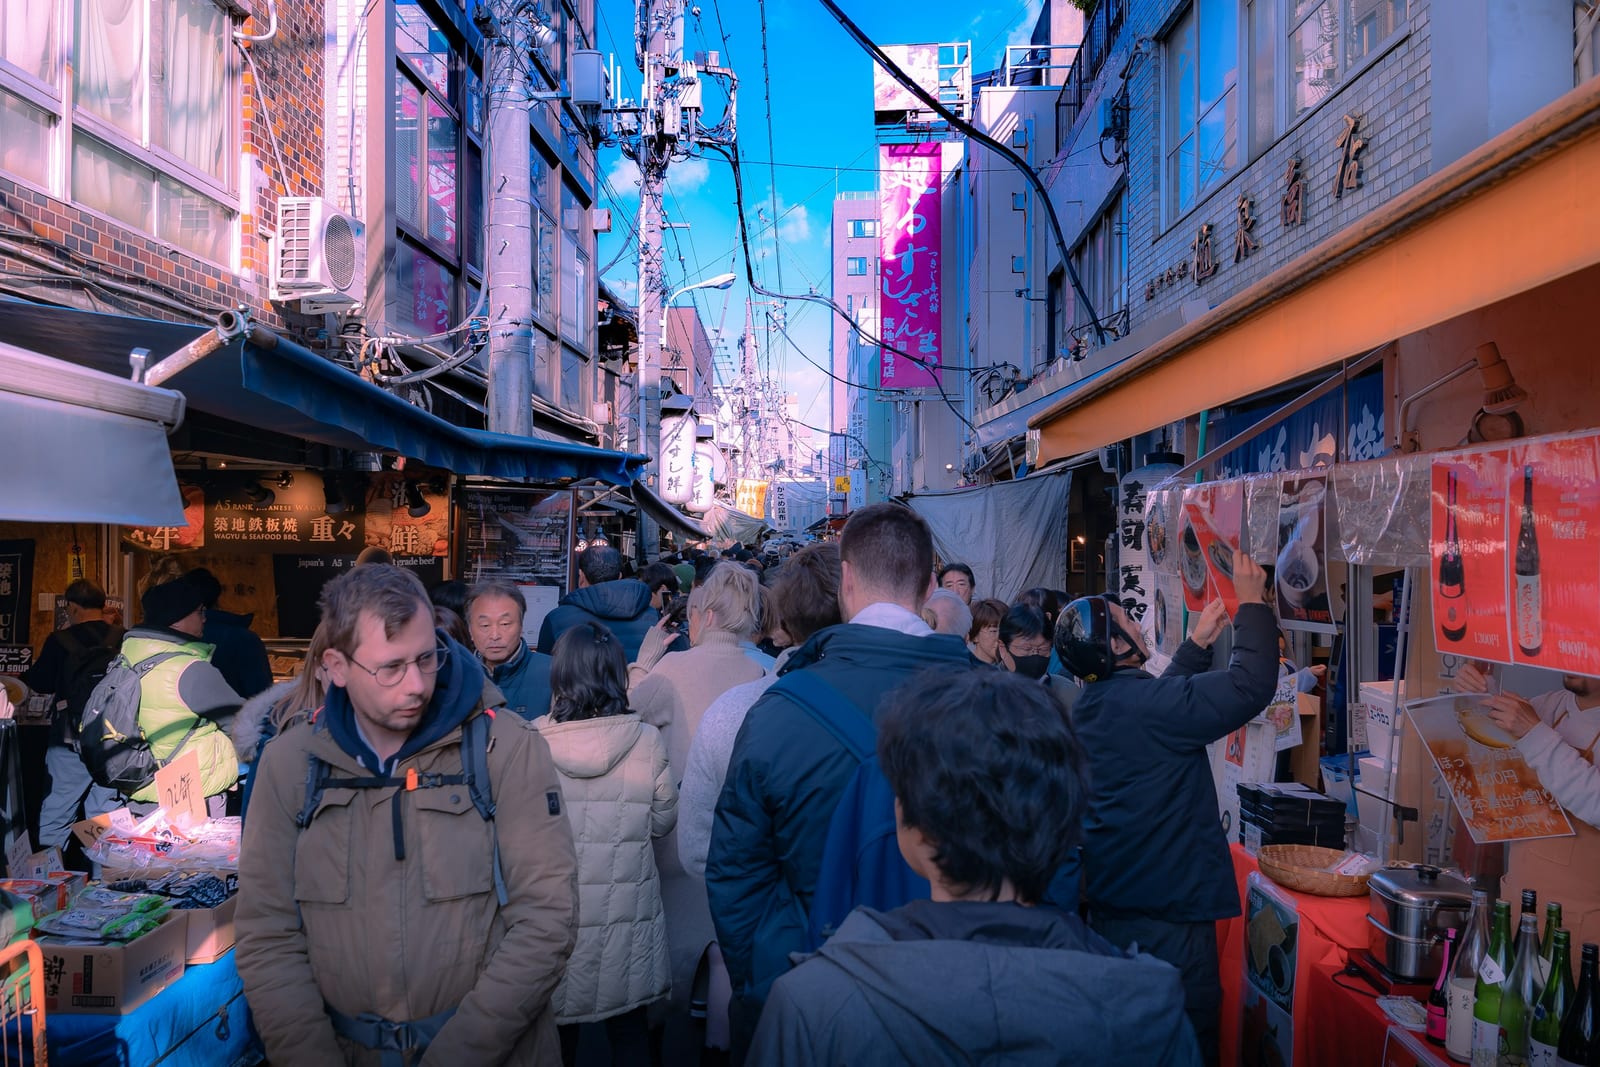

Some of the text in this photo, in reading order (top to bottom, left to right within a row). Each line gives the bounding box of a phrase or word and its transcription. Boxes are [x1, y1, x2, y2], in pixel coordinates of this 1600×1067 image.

[216, 500, 231, 511] A5
[232, 503, 254, 511] RANK
[1121, 481, 1146, 551] 寿司
[214, 517, 297, 533] 築地鉄板焼
[309, 515, 356, 542] 重々
[249, 533, 282, 541] SEAFOOD
[283, 533, 301, 542] BBQ
[331, 558, 342, 567] A5
[397, 557, 418, 568] grade
[419, 556, 435, 566] beef
[7, 664, 30, 673] SOUP
